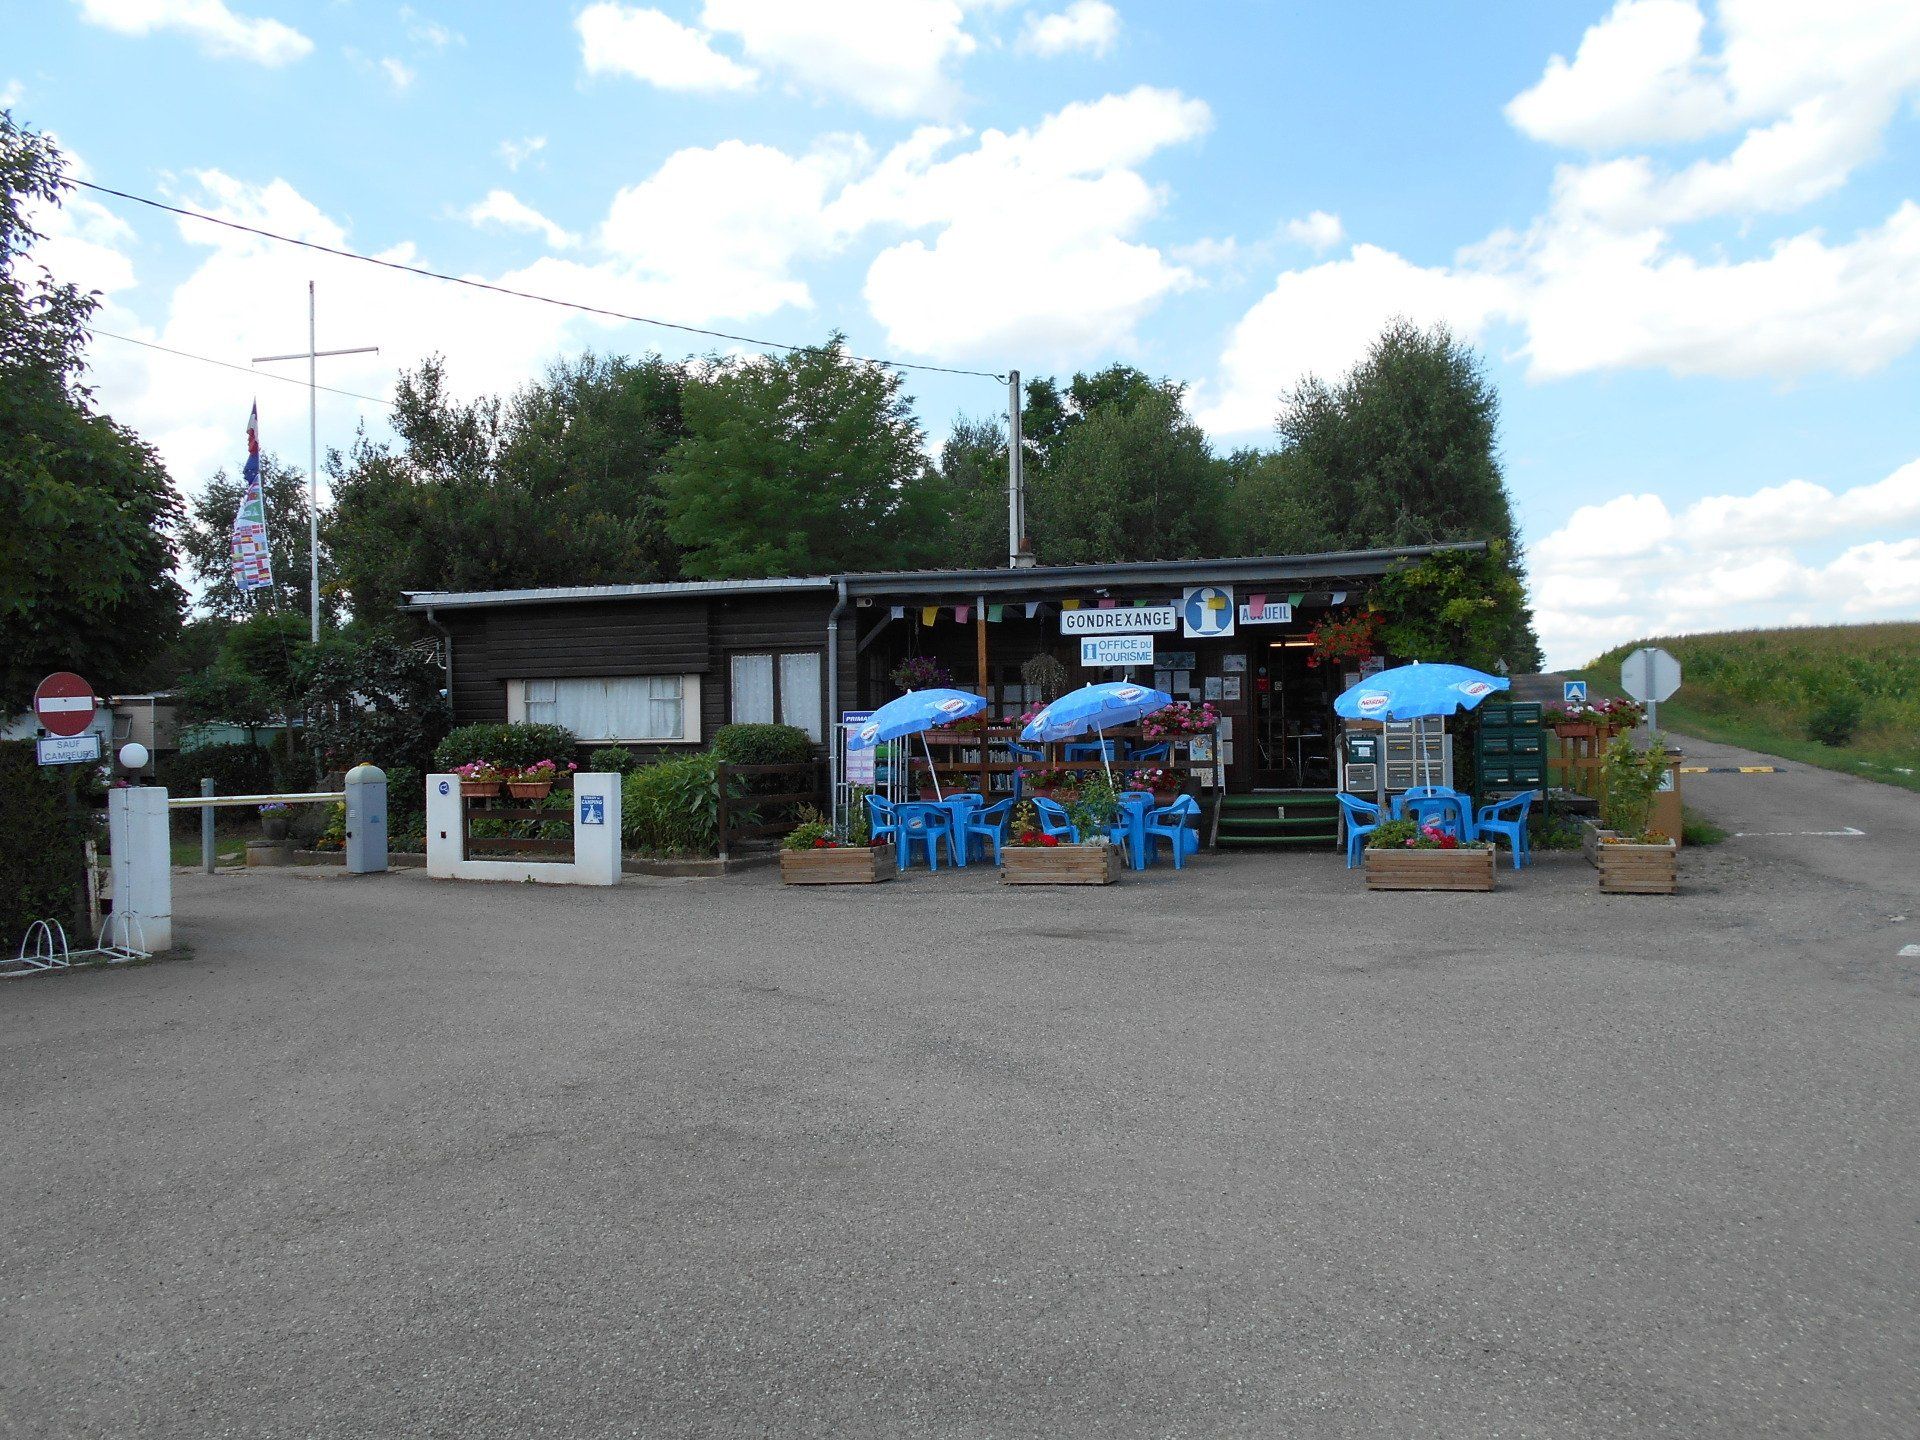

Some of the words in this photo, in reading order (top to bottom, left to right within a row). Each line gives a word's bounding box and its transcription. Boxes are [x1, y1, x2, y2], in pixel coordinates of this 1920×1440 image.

[1242, 606, 1290, 621] AUEIL
[1066, 612, 1171, 628] GONDREXANGE
[1098, 640, 1138, 650] OFFICE
[1140, 641, 1152, 649] DU
[1098, 652, 1152, 662] TOURISME
[57, 740, 81, 749] SAUF
[45, 750, 95, 761] CAMPEURS
